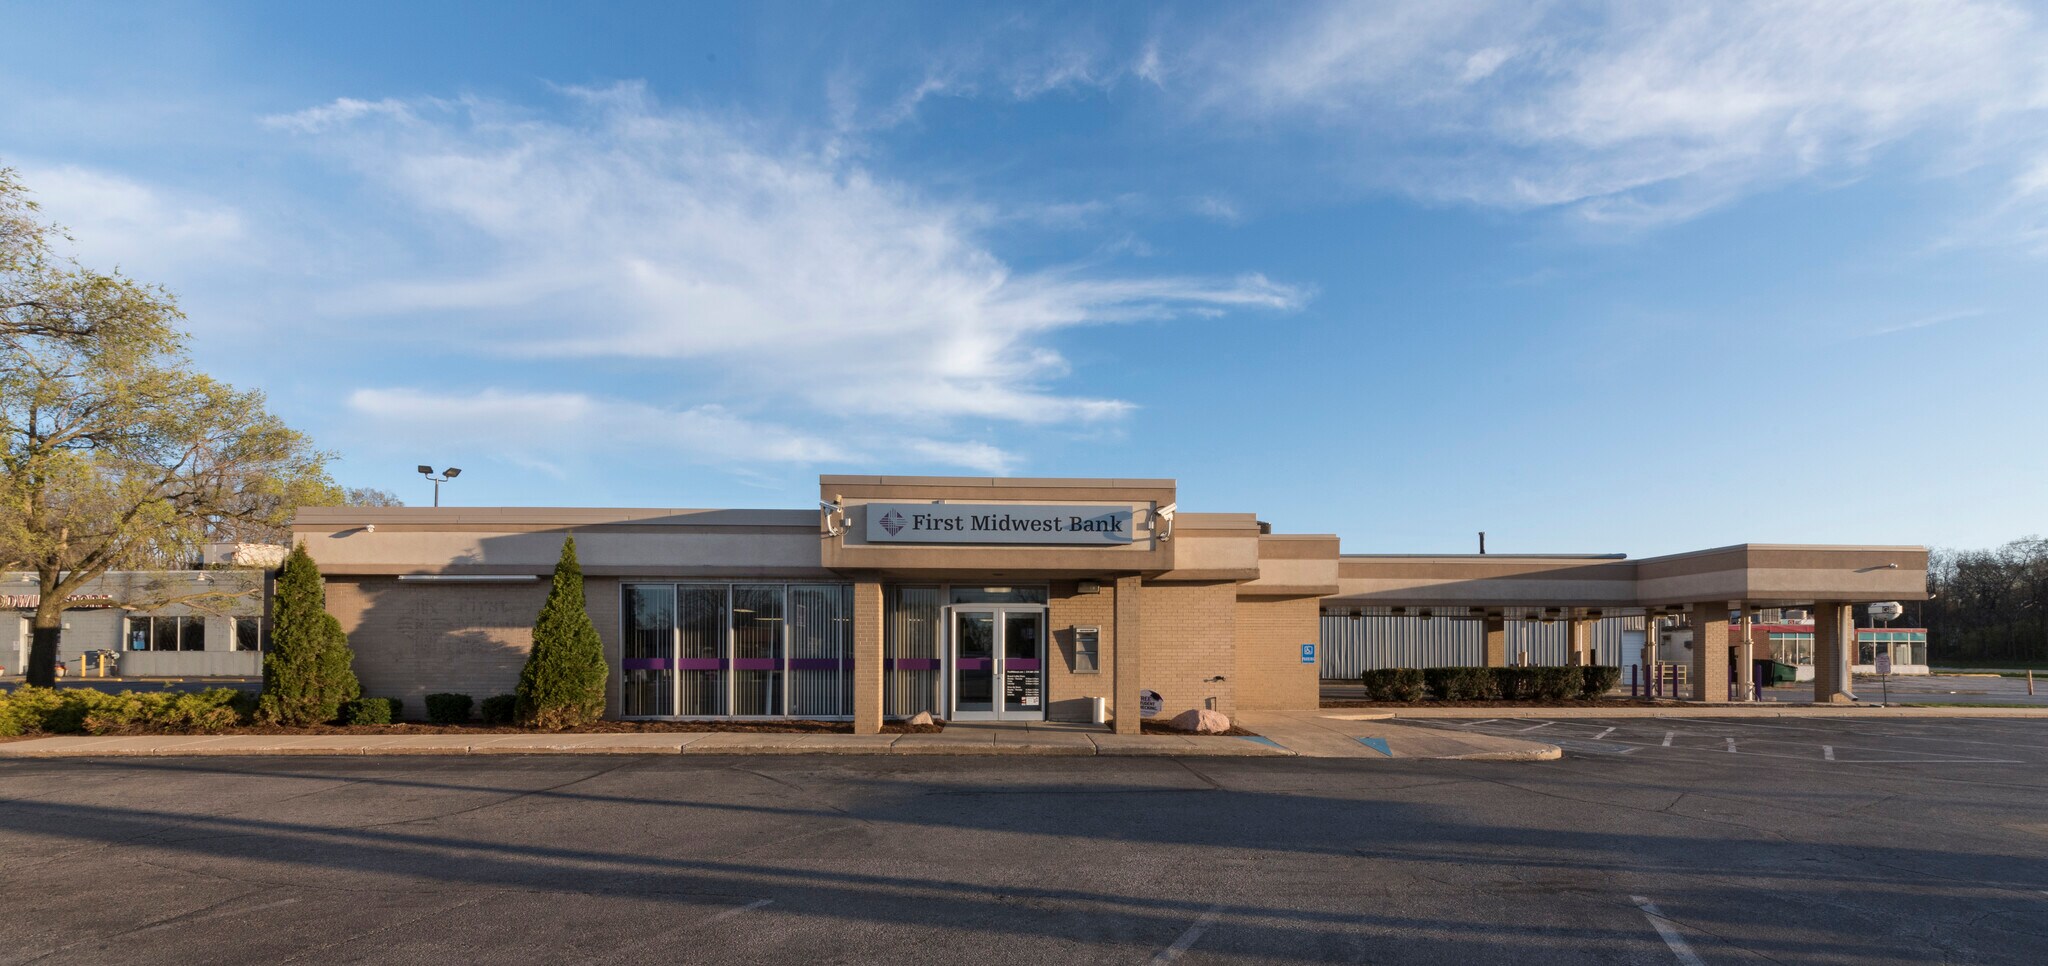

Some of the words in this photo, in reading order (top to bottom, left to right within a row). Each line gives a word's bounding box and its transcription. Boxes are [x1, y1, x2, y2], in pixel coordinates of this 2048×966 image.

[912, 513, 964, 531] First
[971, 514, 1063, 532] Midwest
[1069, 515, 1123, 532] Bank
[65, 595, 113, 608] TORE
